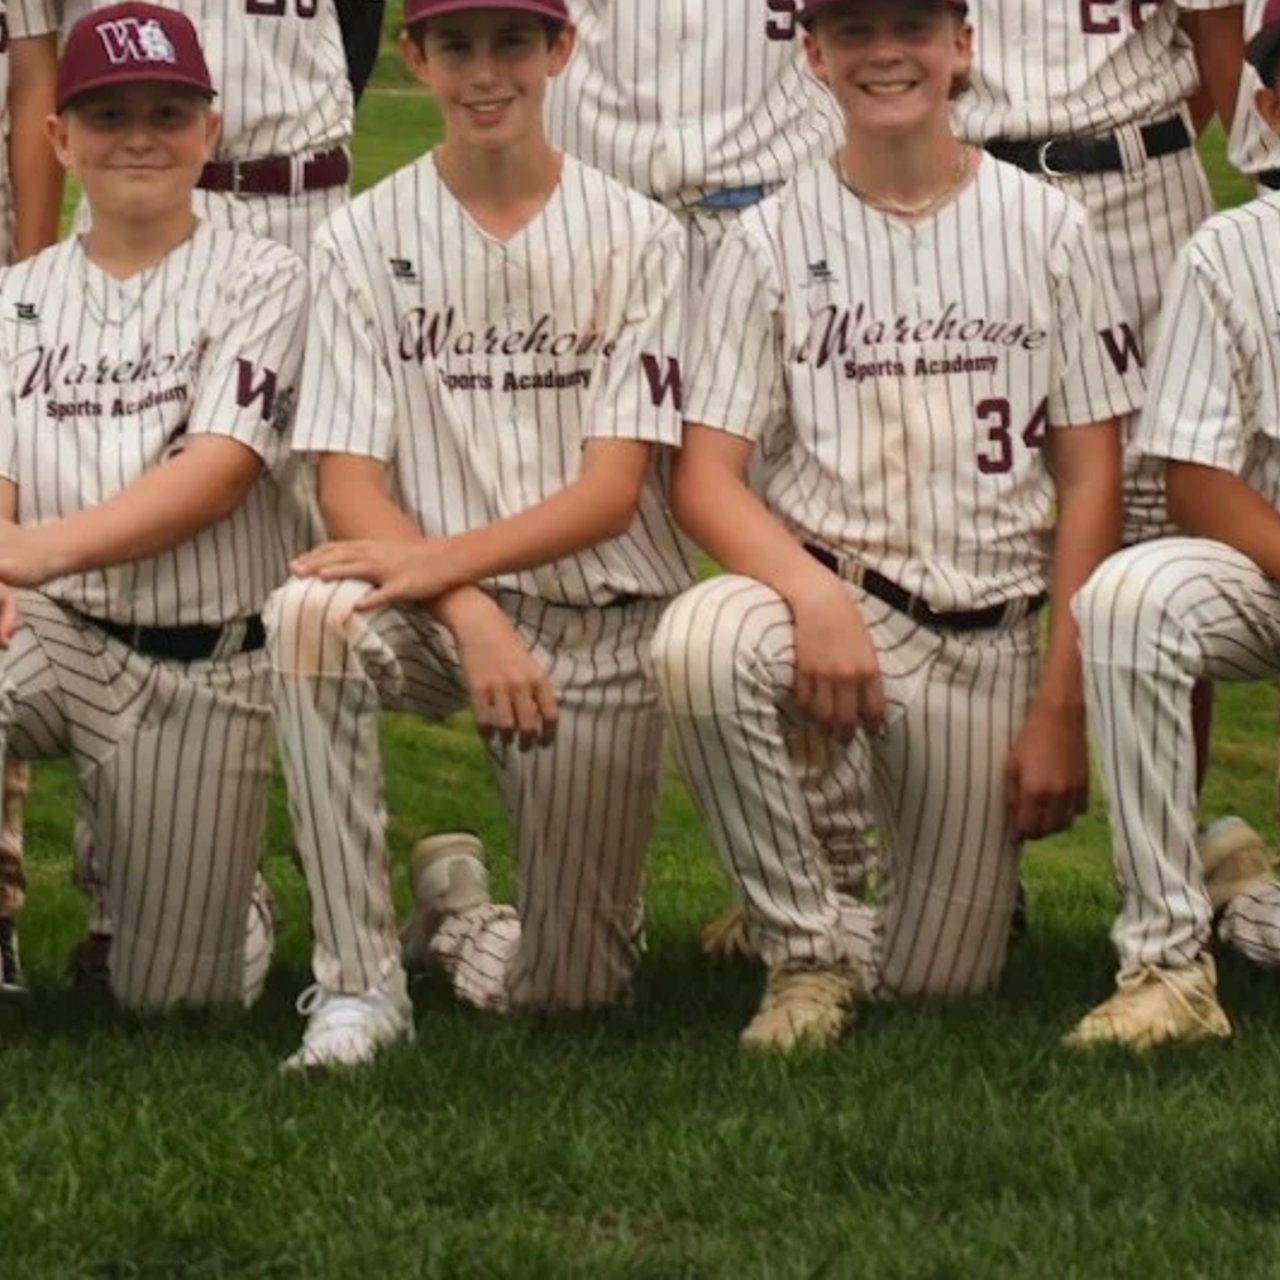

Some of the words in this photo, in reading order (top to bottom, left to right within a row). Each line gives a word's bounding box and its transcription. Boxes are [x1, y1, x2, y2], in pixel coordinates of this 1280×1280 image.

[793, 302, 1047, 369] Warehouse
[1099, 322, 1147, 375] W
[439, 369, 493, 393] pors
[502, 367, 592, 392] Academy
[640, 352, 683, 412] W
[845, 359, 904, 383] Sports
[914, 355, 998, 377] Academy
[47, 398, 103, 424] Sports
[111, 384, 188, 418] Academy
